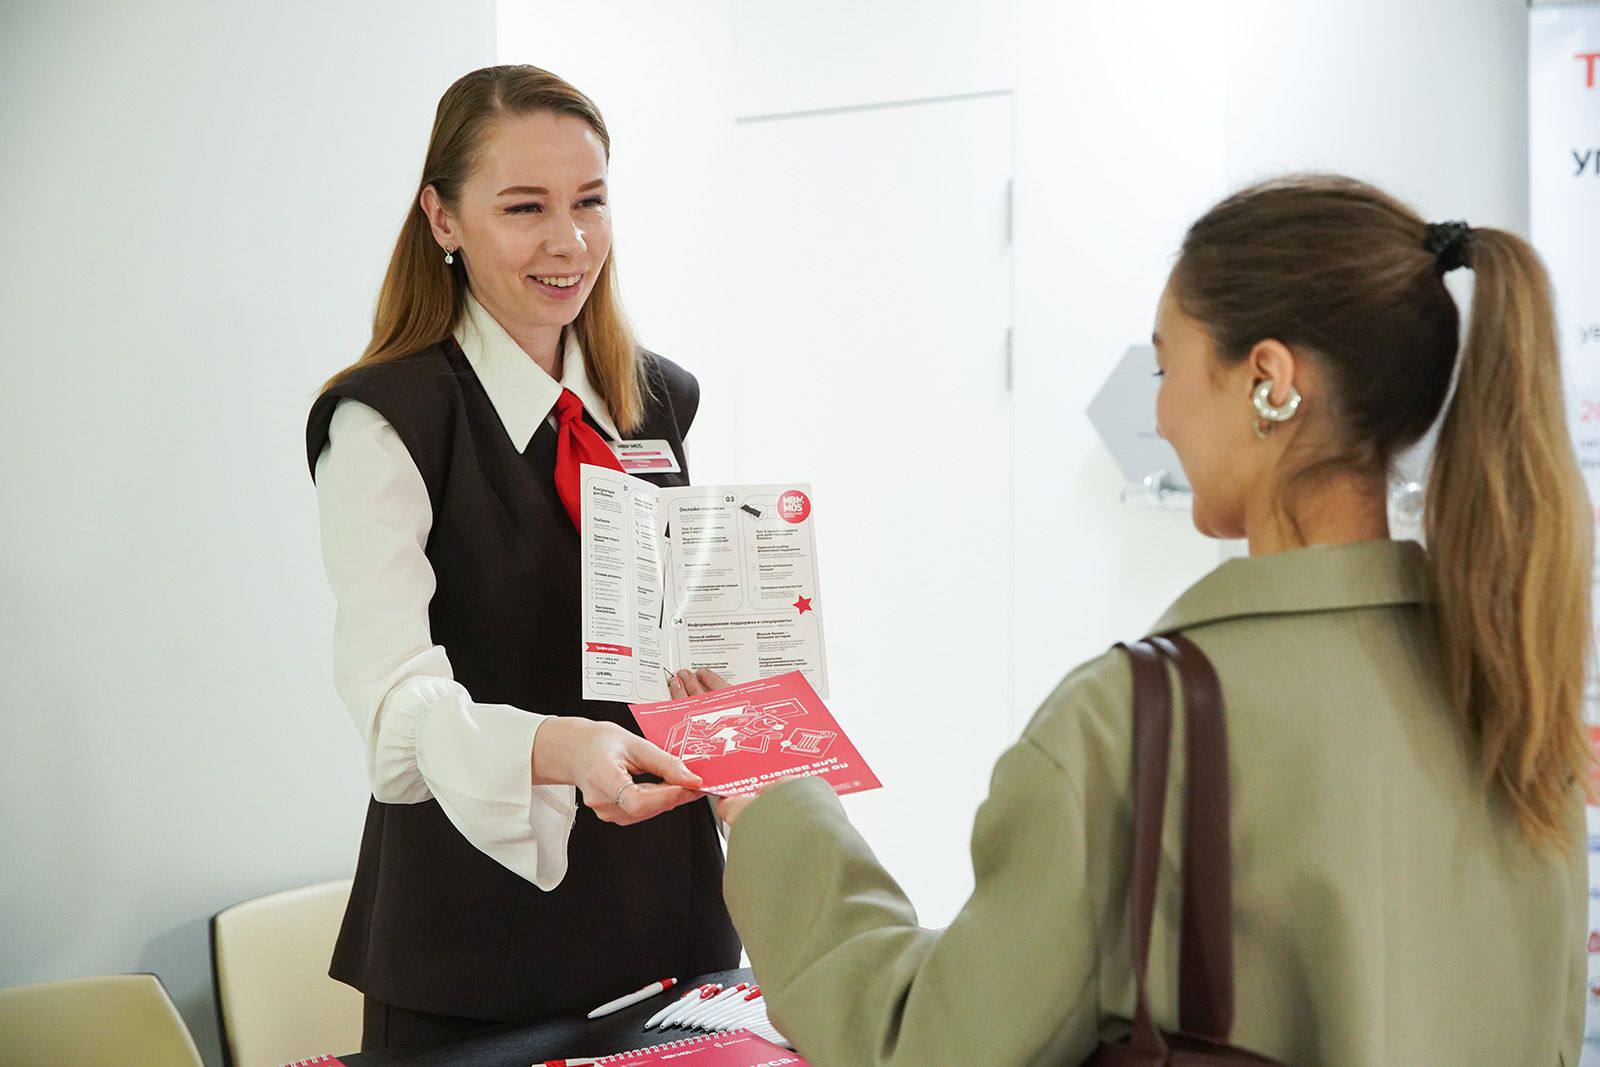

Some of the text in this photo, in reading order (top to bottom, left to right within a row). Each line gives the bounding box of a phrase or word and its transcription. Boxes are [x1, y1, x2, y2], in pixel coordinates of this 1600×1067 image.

[784, 504, 803, 512] MOS
[811, 757, 838, 769] для
[760, 764, 811, 780] вашего
